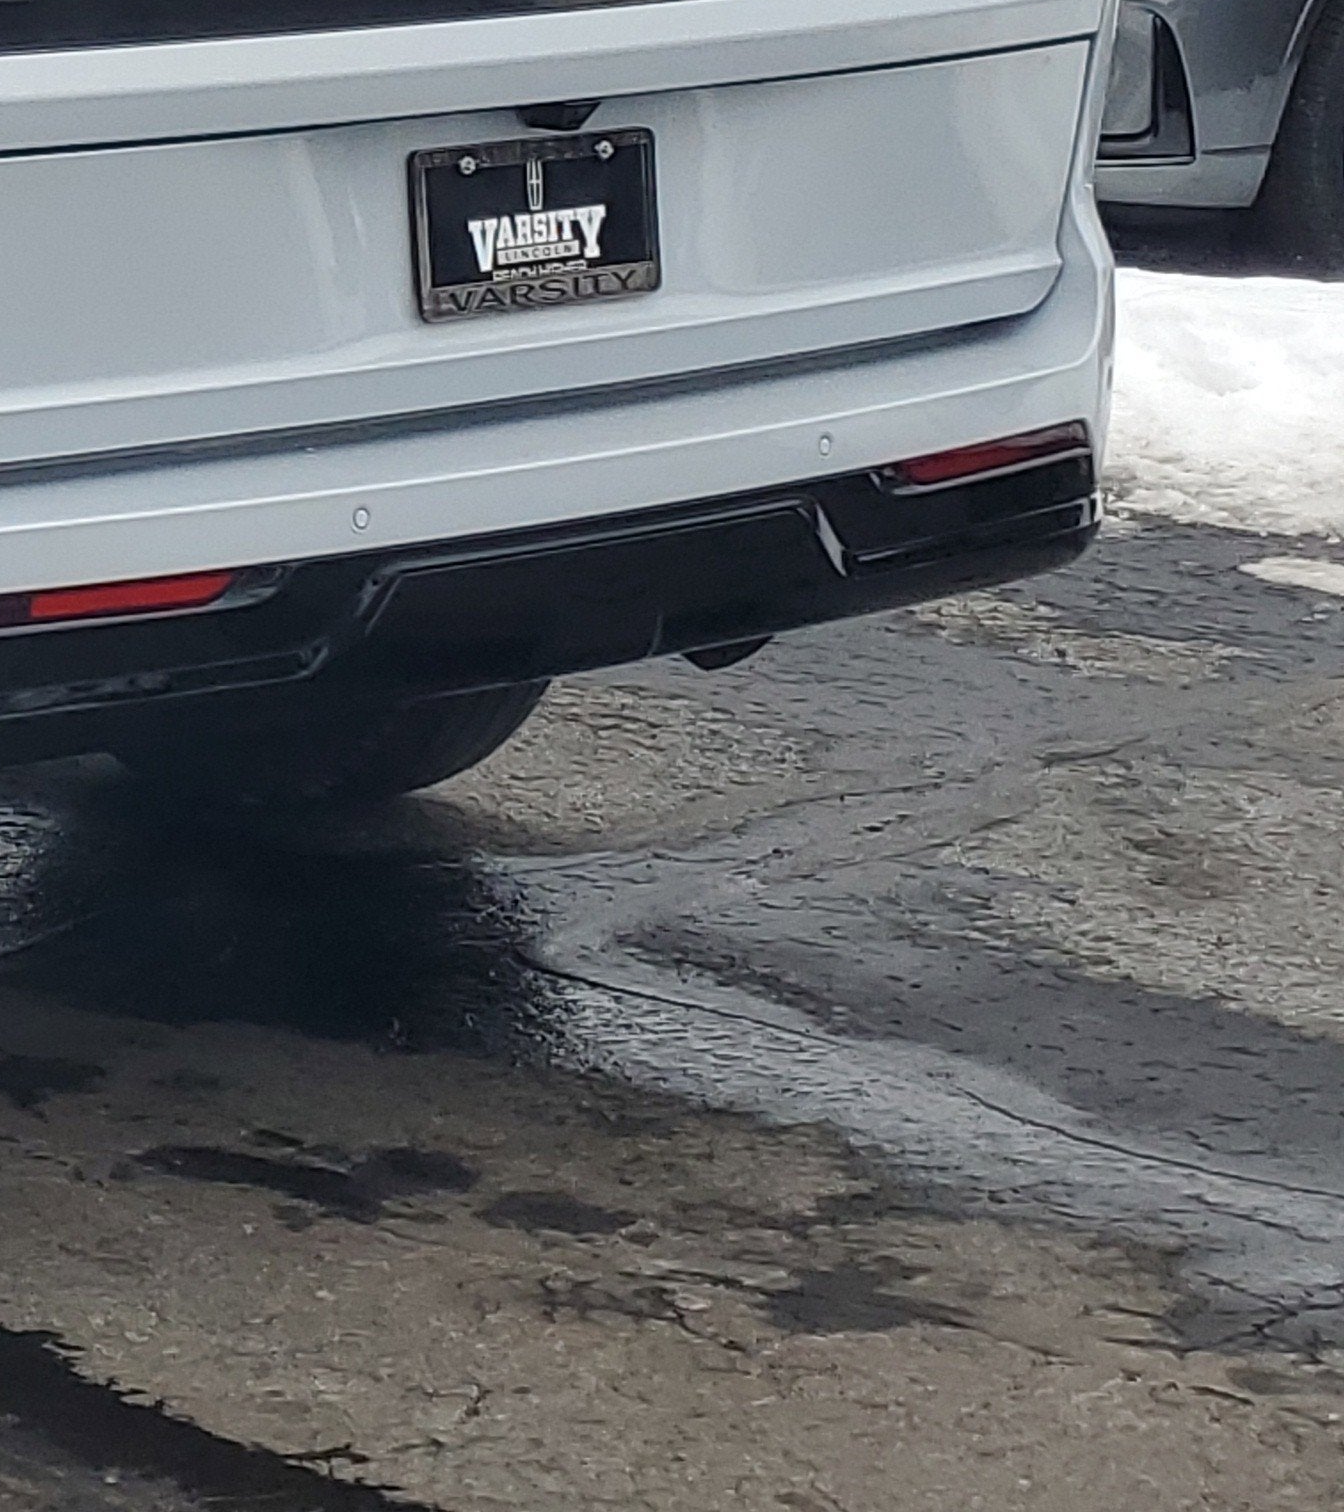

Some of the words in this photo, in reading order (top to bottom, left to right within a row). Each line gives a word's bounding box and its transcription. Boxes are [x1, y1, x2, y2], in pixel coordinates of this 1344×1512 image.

[467, 204, 606, 273] VARSITY
[504, 244, 574, 262] LINCOLN
[449, 270, 636, 312] VARSITY
